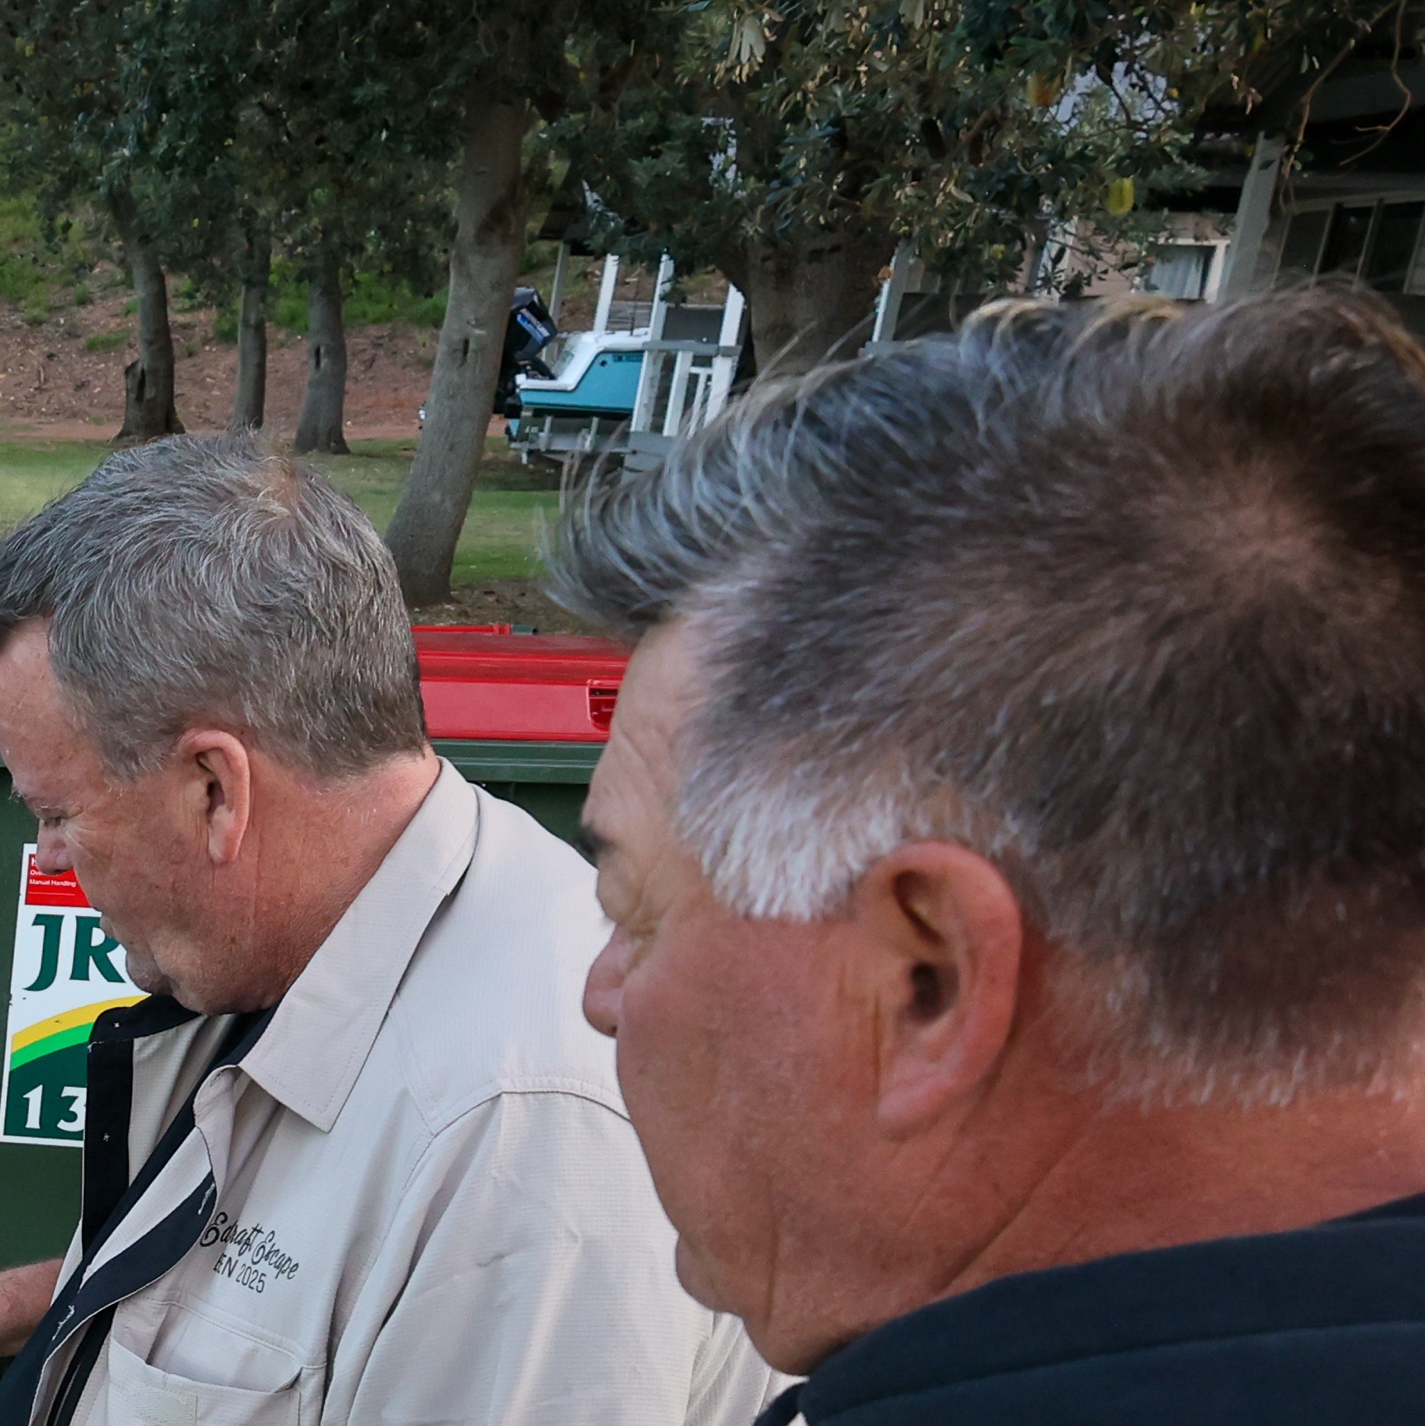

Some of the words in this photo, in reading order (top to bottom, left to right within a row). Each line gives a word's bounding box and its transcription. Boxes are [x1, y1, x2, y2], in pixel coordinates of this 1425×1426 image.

[51, 880, 77, 888] Handling
[23, 914, 127, 992] JR
[251, 1230, 299, 1280] Escape
[236, 1263, 267, 1293] 2025
